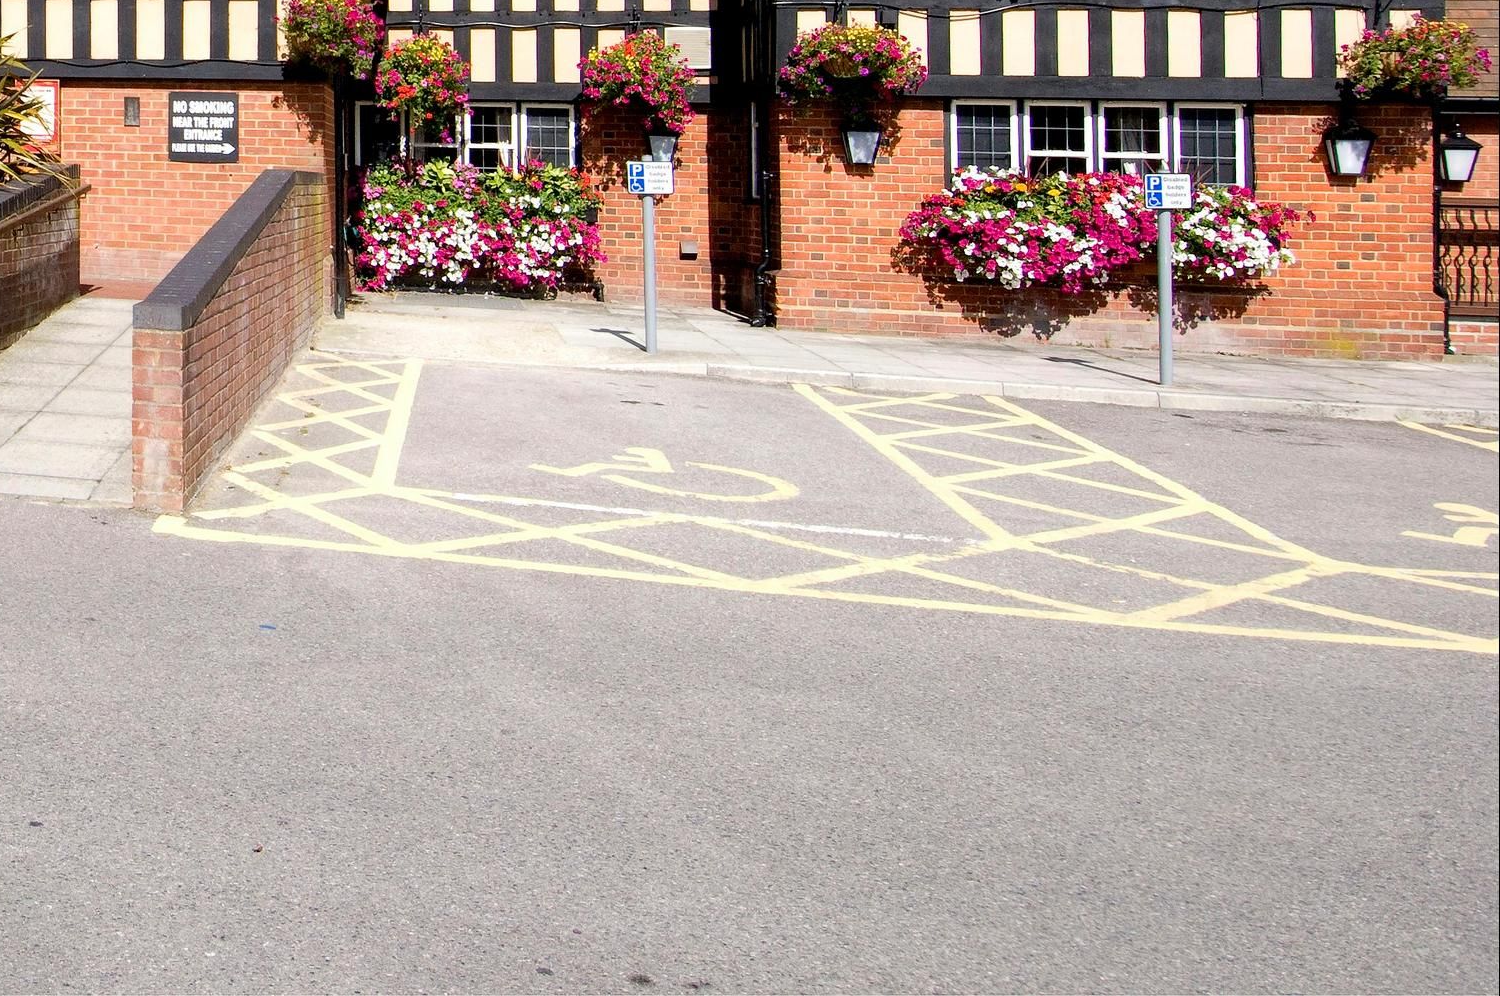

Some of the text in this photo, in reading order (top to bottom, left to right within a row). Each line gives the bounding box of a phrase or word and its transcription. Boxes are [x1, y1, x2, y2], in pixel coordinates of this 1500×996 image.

[173, 100, 235, 115] NO SMOKING
[172, 116, 235, 129] NEAR THE FRONT
[183, 129, 223, 141] ENTRANCE
[632, 164, 643, 177] P
[1150, 176, 1160, 190] P
